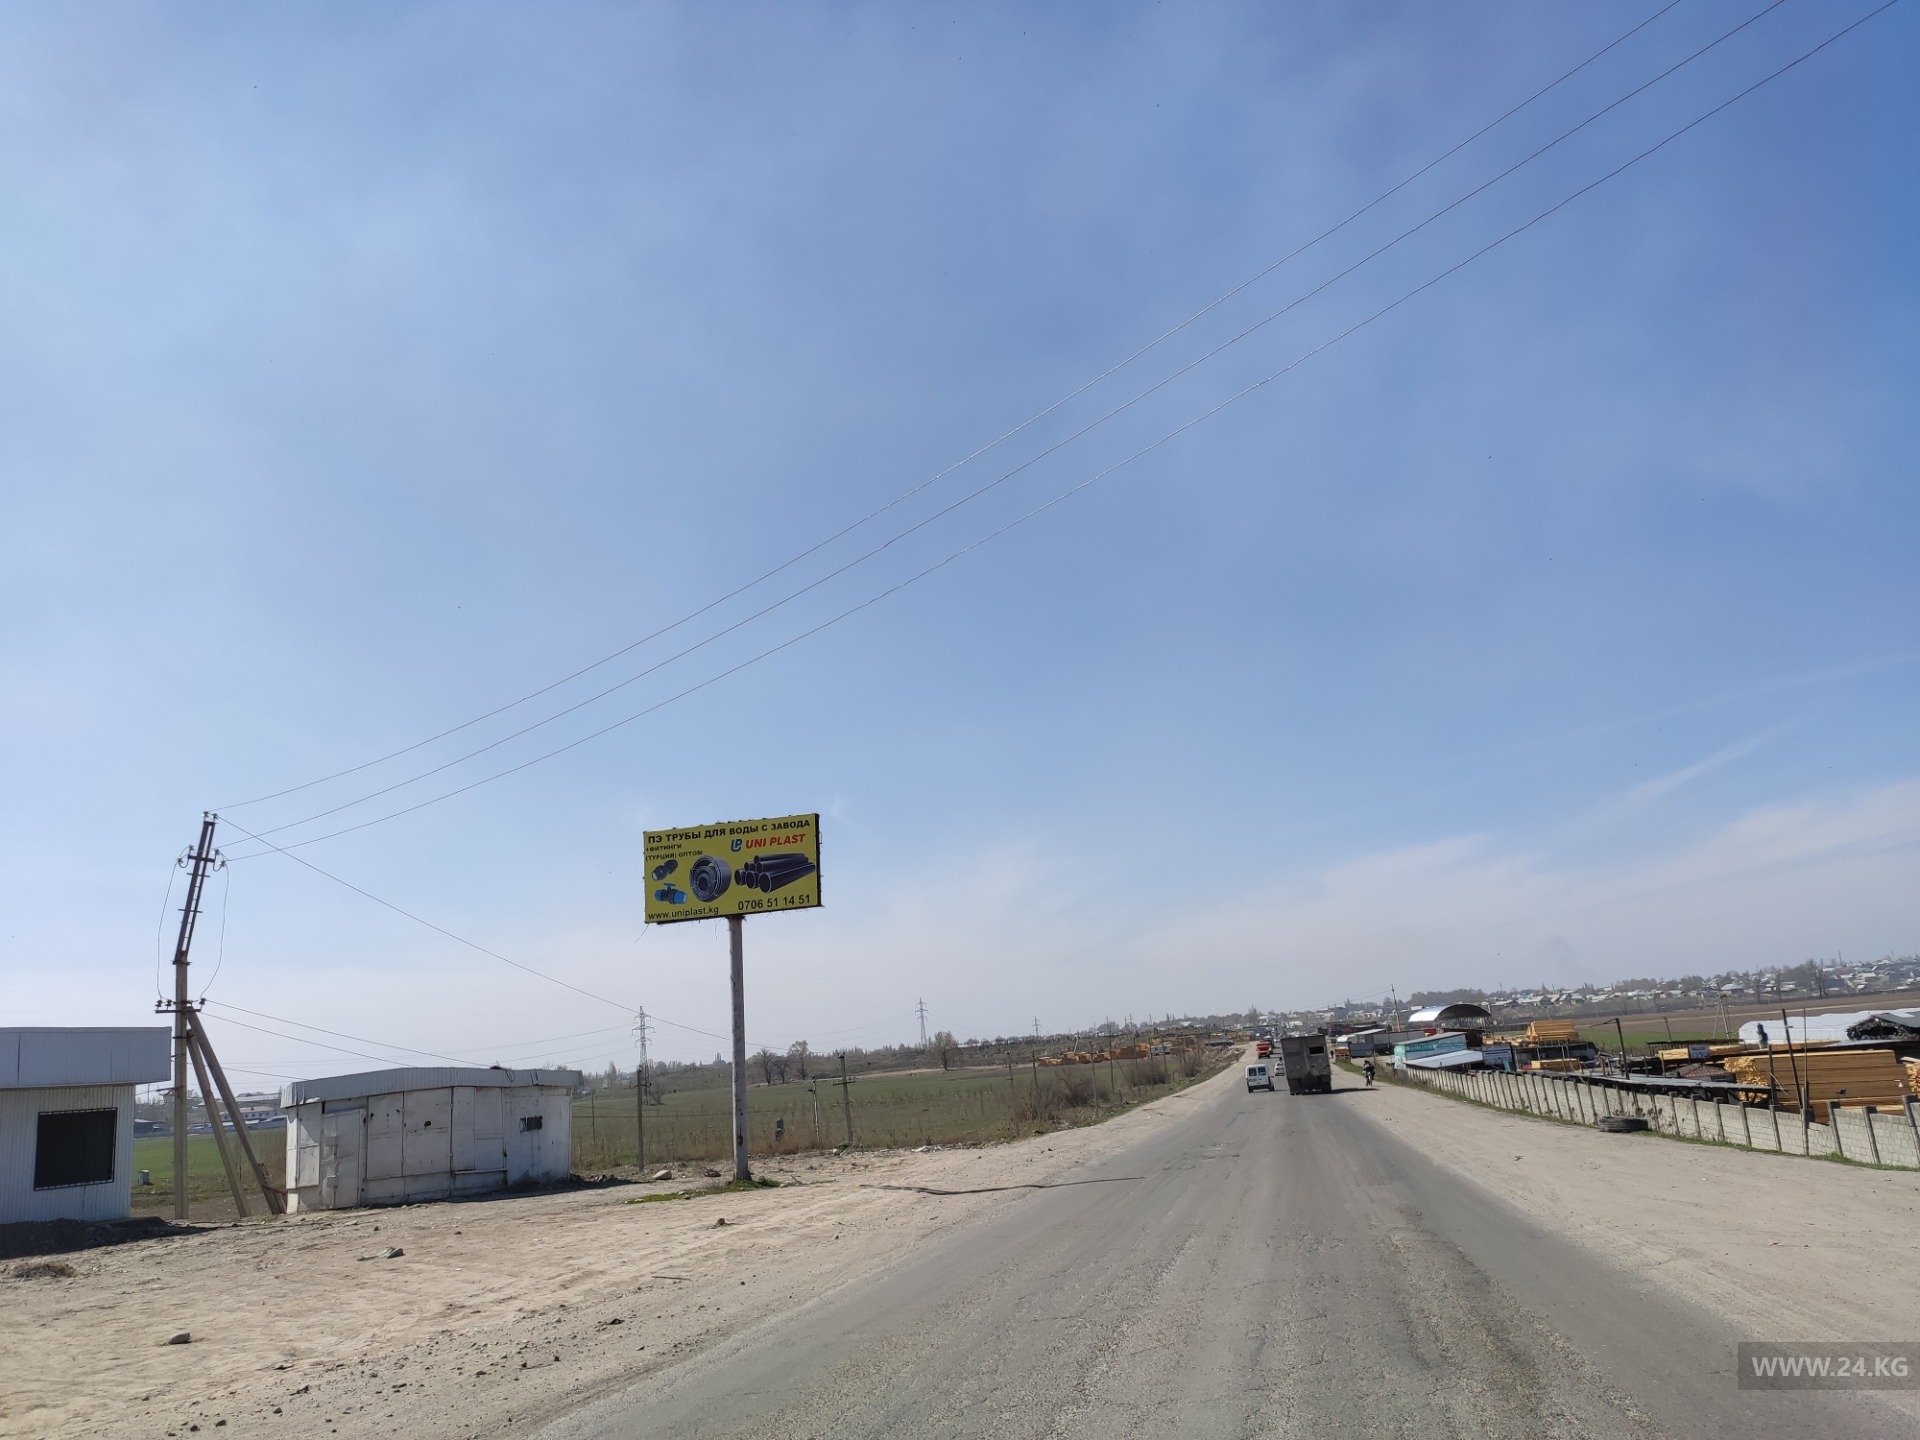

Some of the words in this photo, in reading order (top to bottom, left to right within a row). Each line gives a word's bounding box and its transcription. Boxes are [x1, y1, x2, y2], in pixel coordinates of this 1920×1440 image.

[648, 835, 662, 844] ПЭ
[665, 831, 701, 842] ТРУБЫ
[704, 828, 726, 839] ДЛЯ
[729, 825, 758, 835] ВОДЫ
[771, 819, 810, 831] ЗАВОДА
[745, 838, 767, 849] UNI
[769, 833, 806, 846] PLAST
[678, 850, 703, 858] ОПТОМ
[737, 898, 764, 911] 0706
[766, 896, 778, 907] 51
[783, 895, 795, 906] 14
[798, 894, 811, 904] 51
[648, 906, 719, 920] www.uniplast.kg
